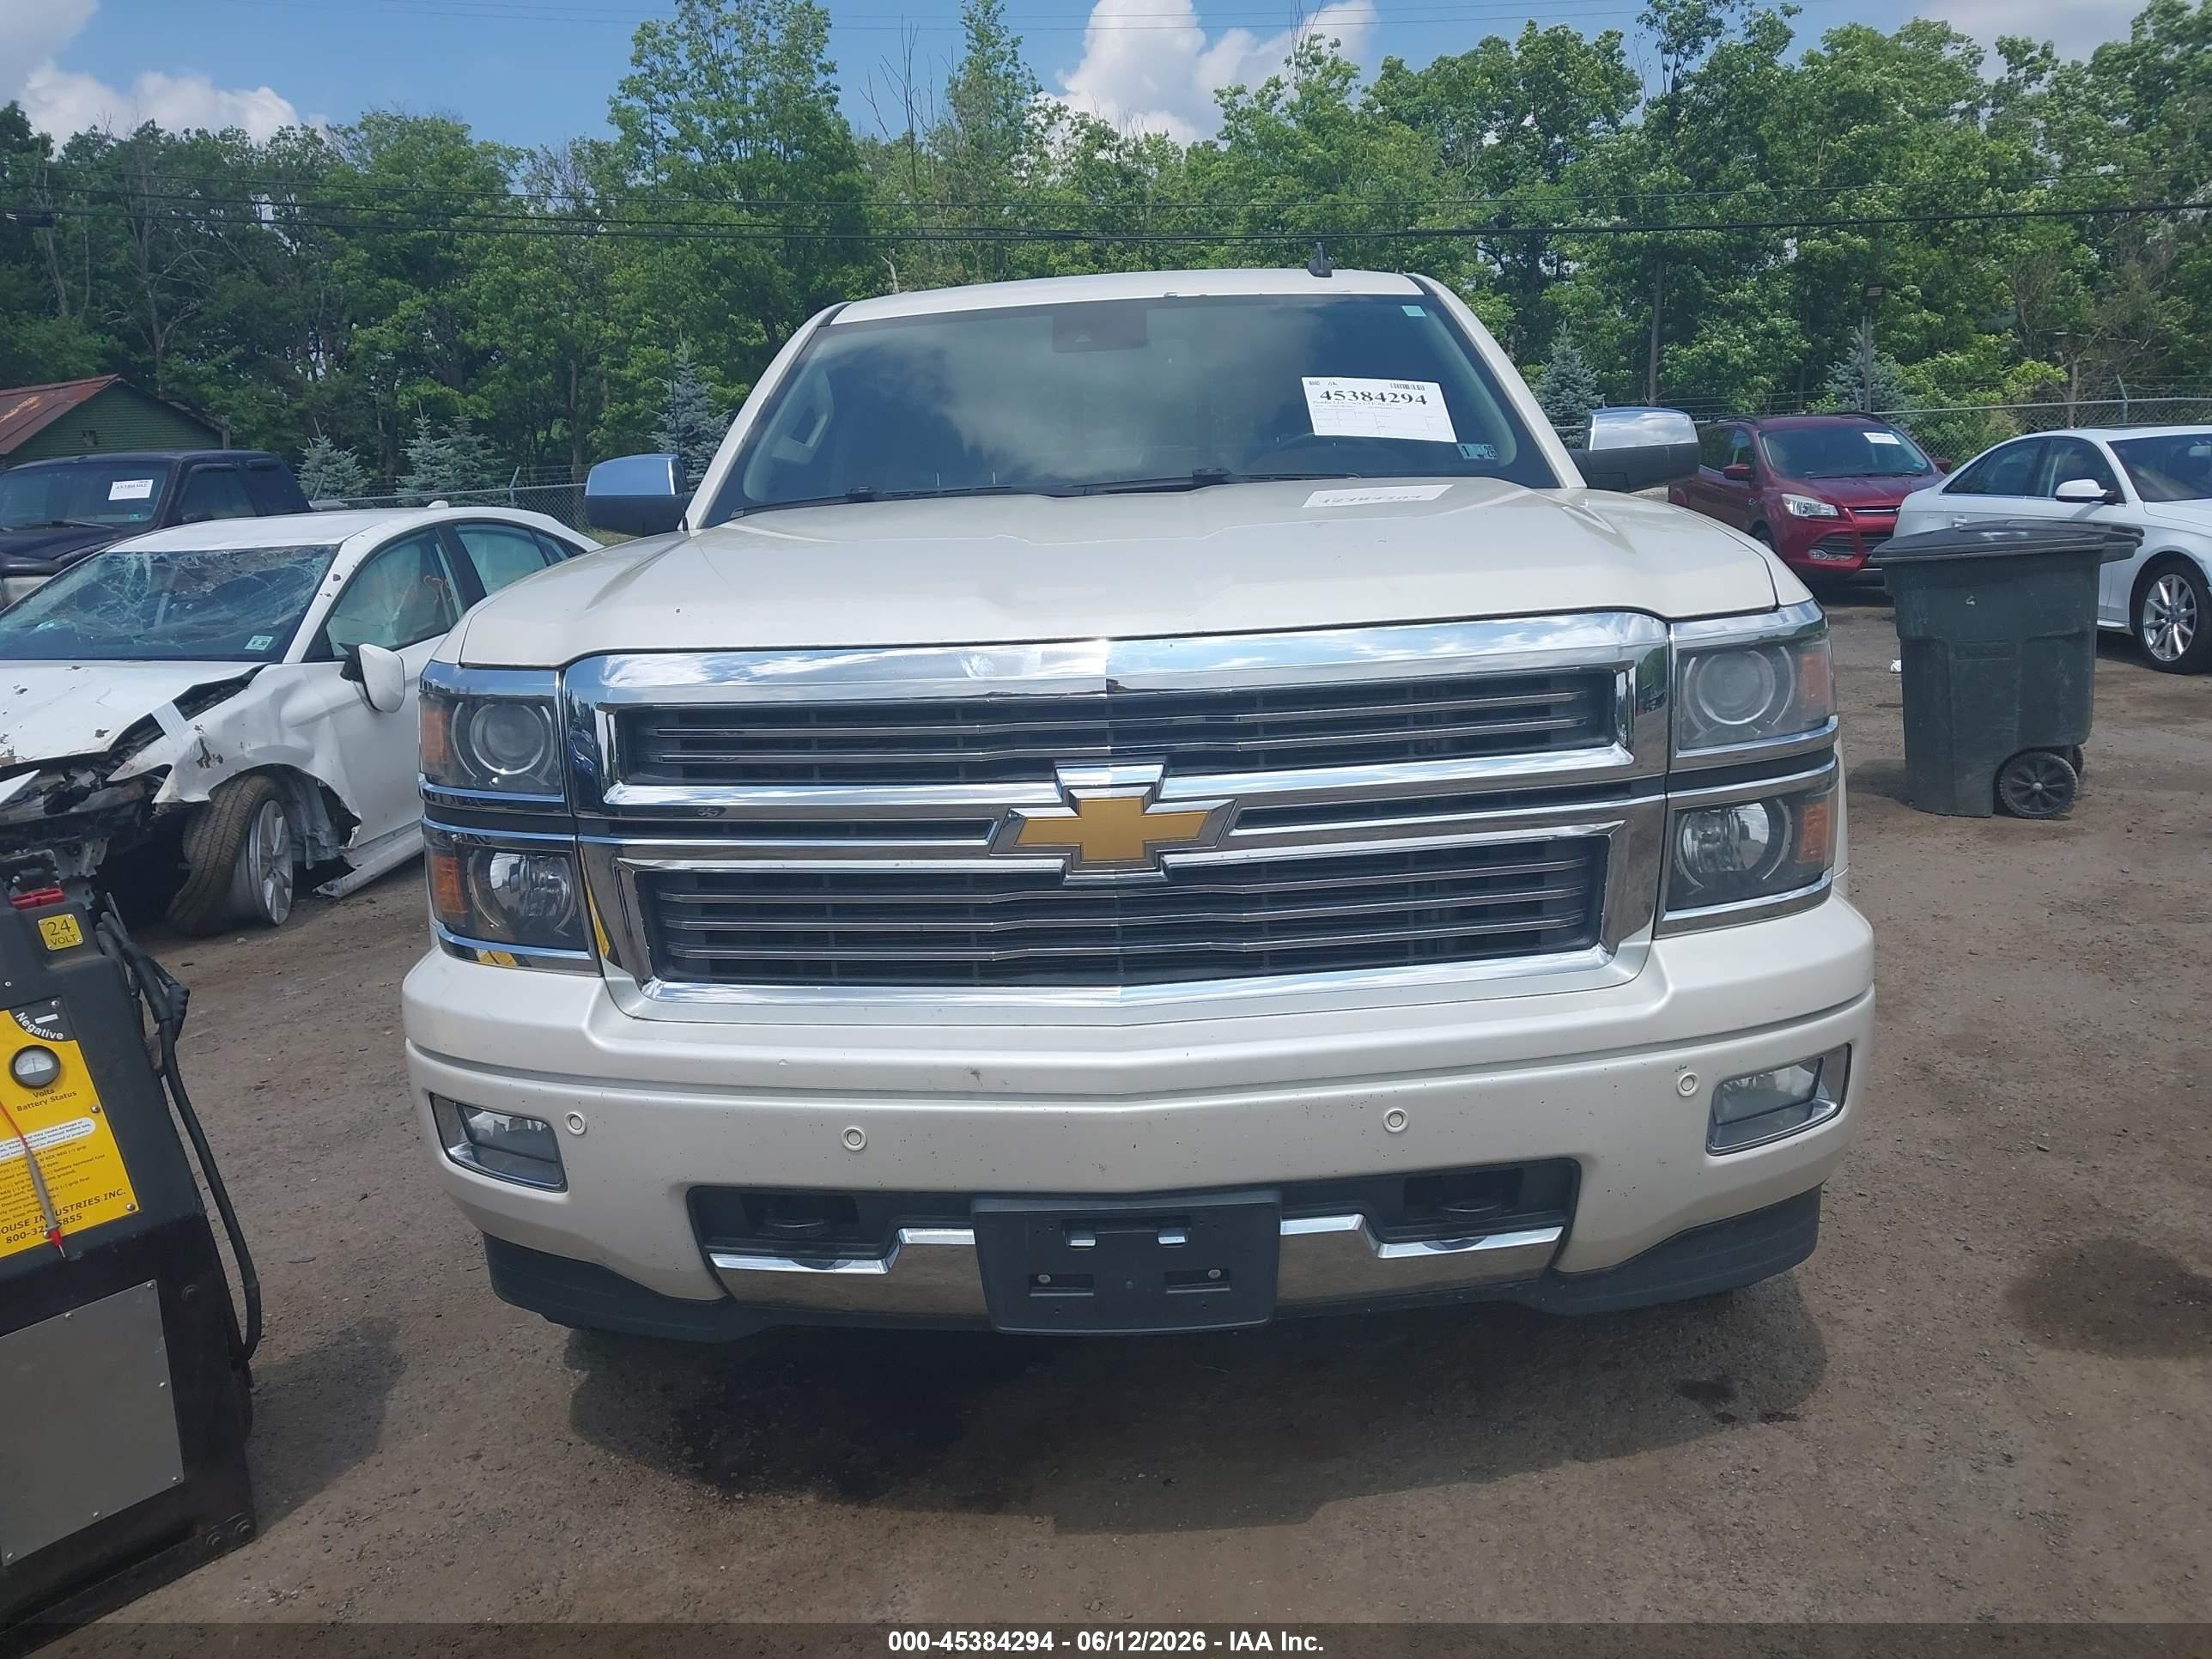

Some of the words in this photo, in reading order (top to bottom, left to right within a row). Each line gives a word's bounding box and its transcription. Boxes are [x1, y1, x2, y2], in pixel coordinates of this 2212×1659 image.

[1320, 390, 1428, 405] 45384294
[46, 919, 71, 936] 24
[50, 933, 76, 946] VOLT
[15, 1012, 64, 1041] Negative
[16, 1099, 48, 1112] Battery
[50, 1090, 77, 1103] Status
[33, 1088, 56, 1098] Volts
[34, 1196, 101, 1224] INUSTRIES
[102, 1188, 127, 1200] INC.
